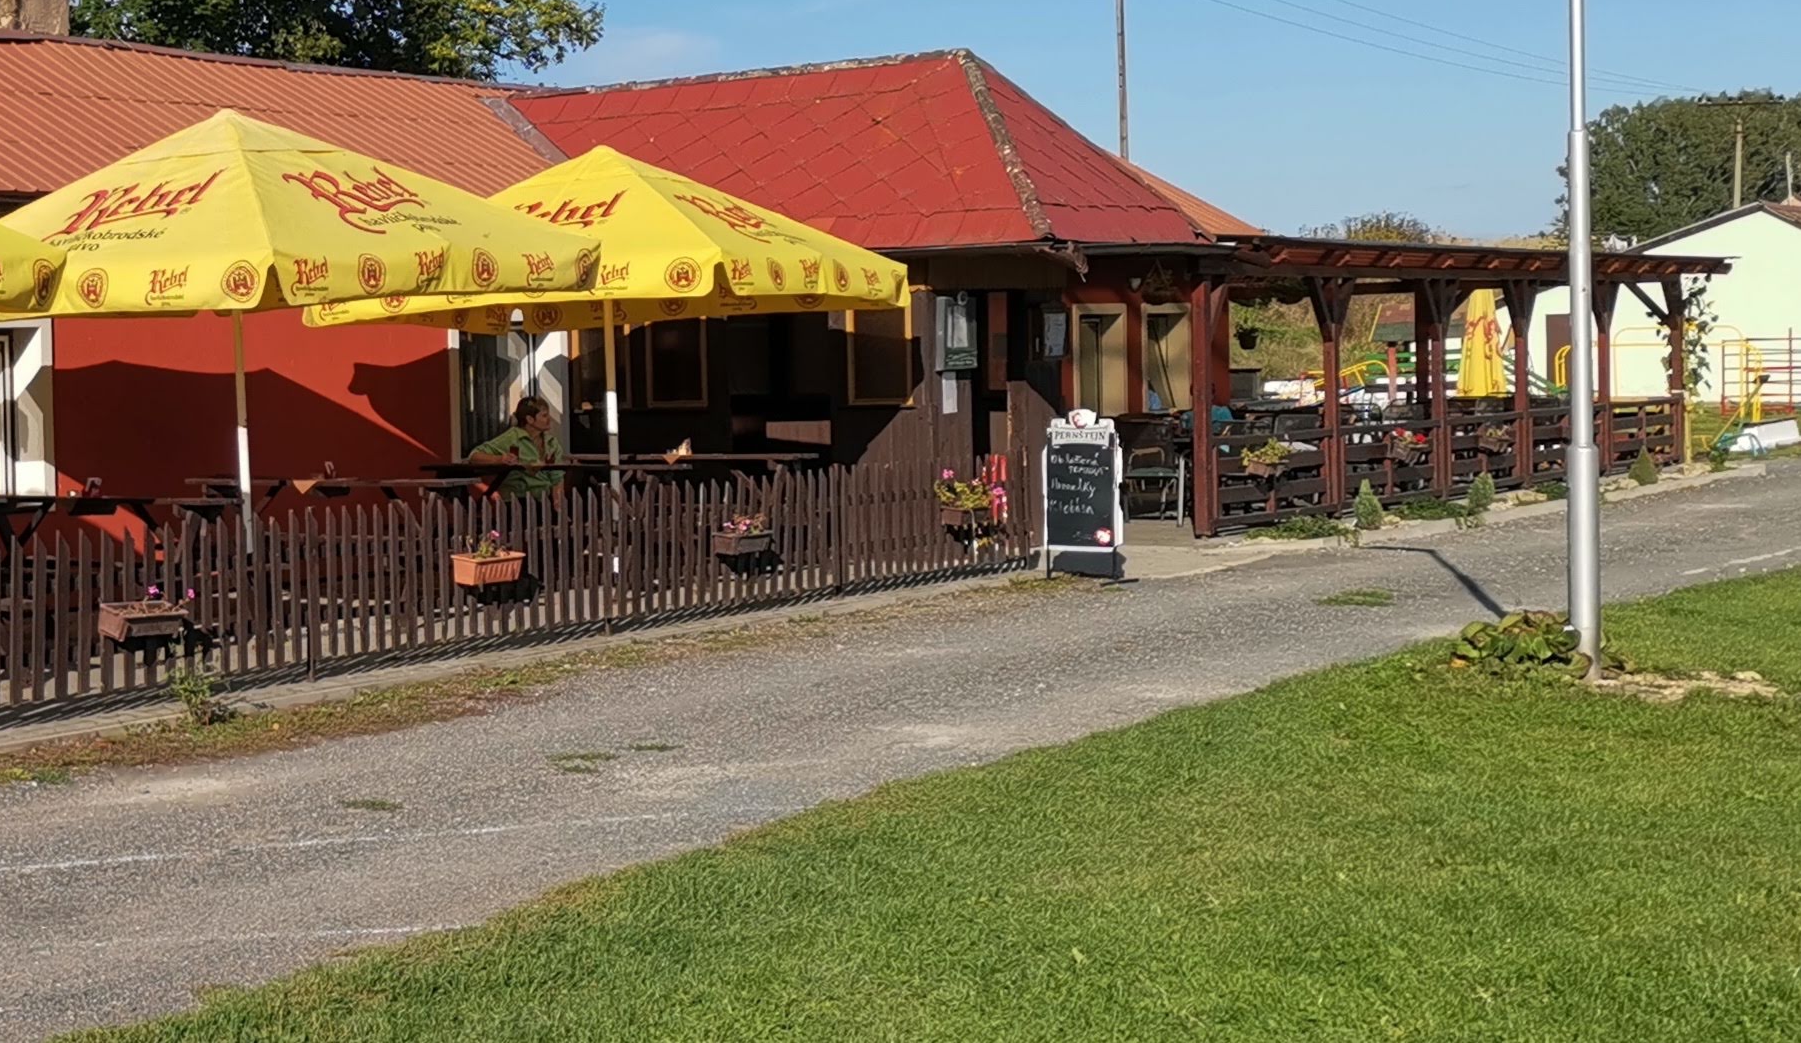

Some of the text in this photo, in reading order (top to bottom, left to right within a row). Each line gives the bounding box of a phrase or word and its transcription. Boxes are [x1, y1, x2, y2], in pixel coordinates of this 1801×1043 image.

[41, 166, 228, 242] Rebel
[281, 166, 425, 234] Rebel
[513, 187, 630, 229] bel
[145, 264, 190, 306] Rebel
[291, 256, 329, 296] Rebel
[1054, 430, 1106, 441] PERNŠTEJN
